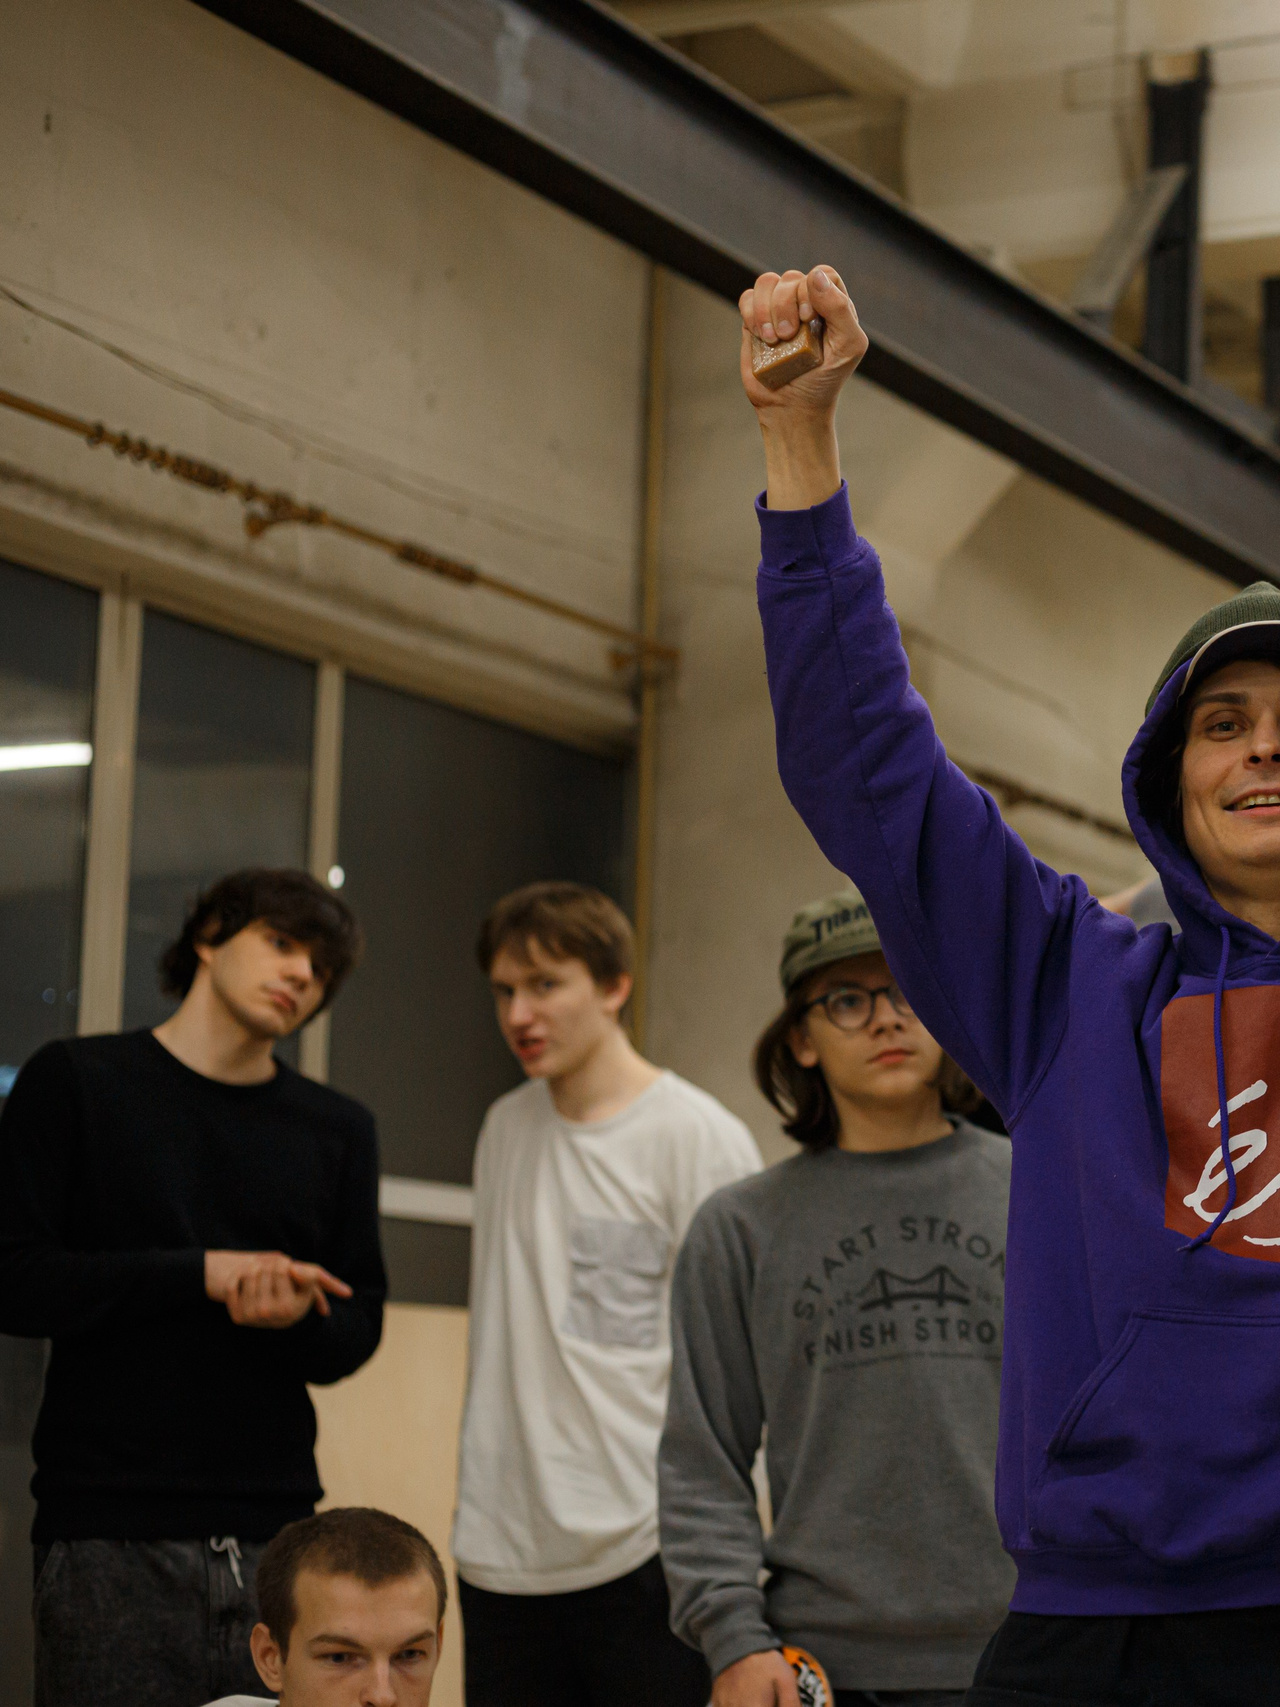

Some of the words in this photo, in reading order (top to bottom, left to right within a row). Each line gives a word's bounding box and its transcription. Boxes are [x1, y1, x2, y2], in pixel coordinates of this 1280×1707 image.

[793, 1224, 877, 1320] START
[899, 1215, 1005, 1278] STRON
[804, 1322, 897, 1366] FNISH
[914, 1317, 996, 1345] STRO
